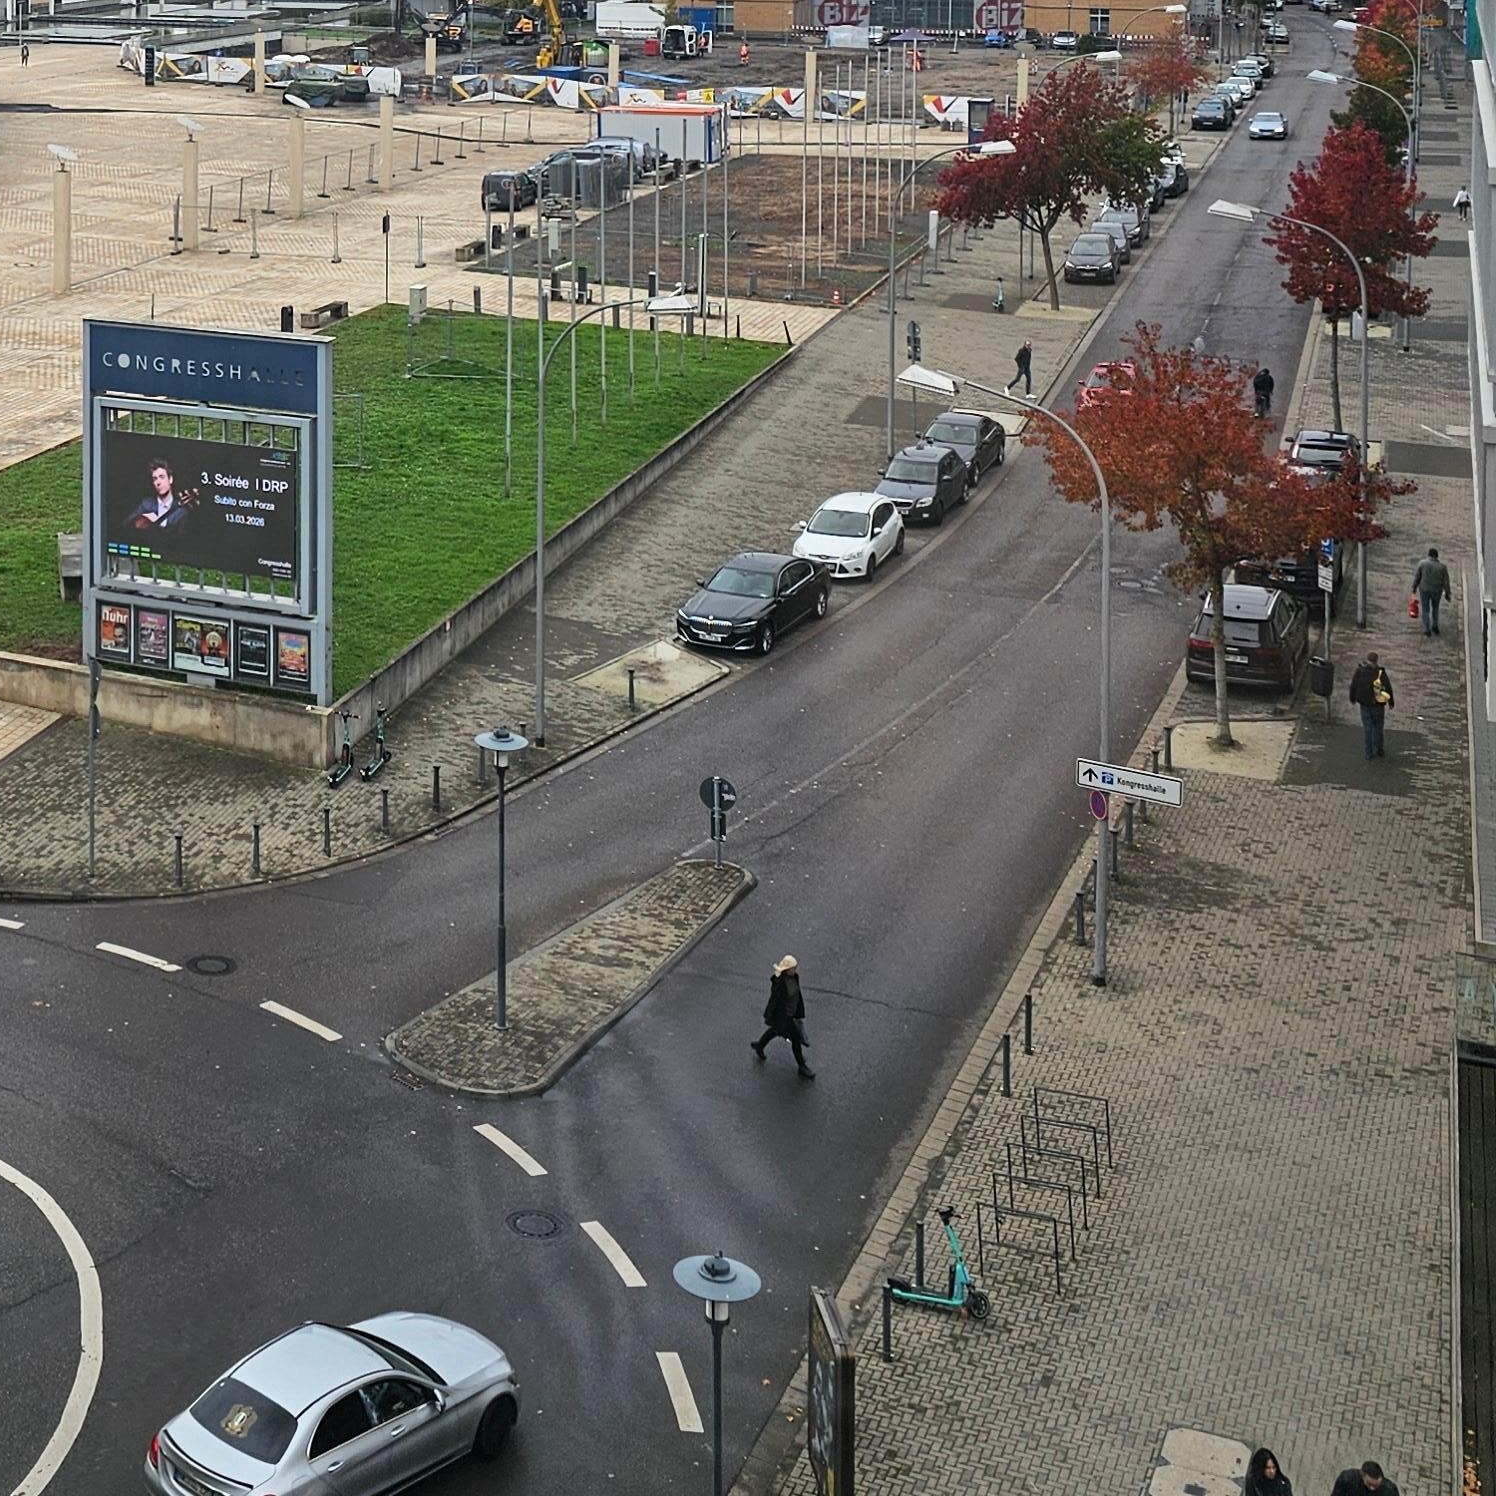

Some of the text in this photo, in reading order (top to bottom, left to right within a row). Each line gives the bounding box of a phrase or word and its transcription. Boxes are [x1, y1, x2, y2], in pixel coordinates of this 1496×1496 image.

[201, 471, 212, 485] 3.
[214, 473, 249, 490] Soirée
[262, 479, 288, 494] DRP
[214, 494, 275, 511] Subito con Forza
[1117, 777, 1167, 795] Kongresshalle
